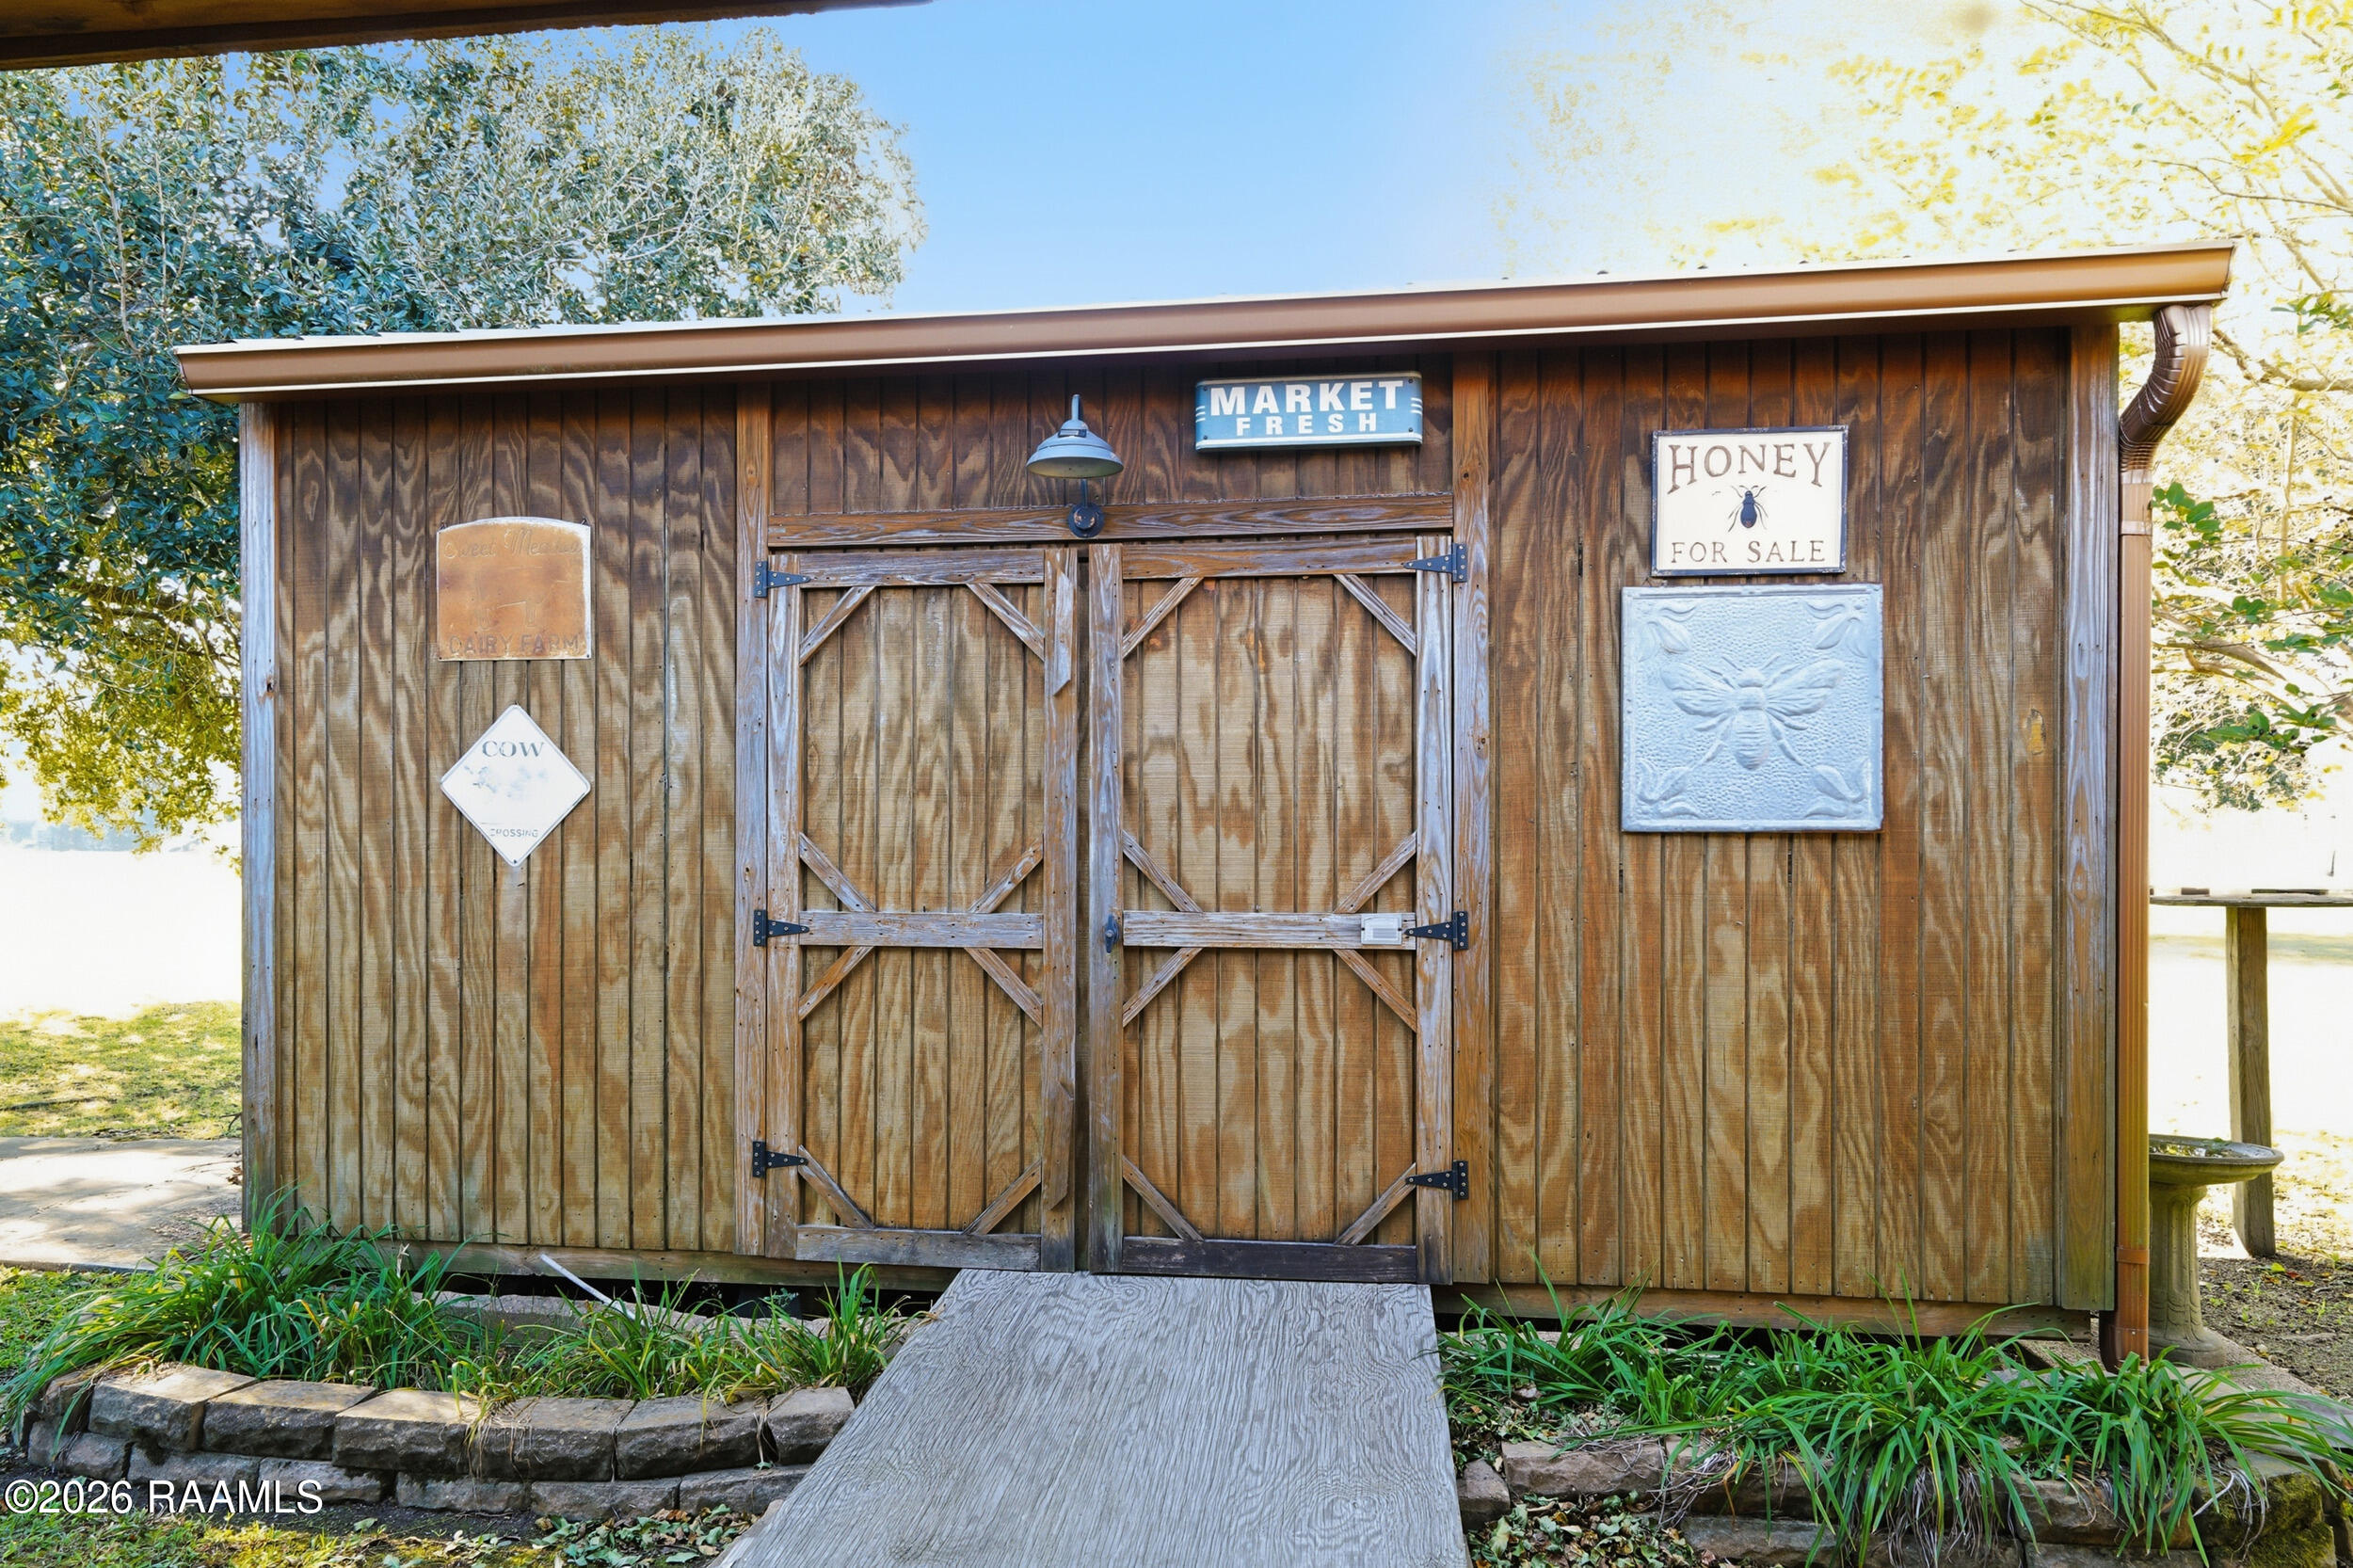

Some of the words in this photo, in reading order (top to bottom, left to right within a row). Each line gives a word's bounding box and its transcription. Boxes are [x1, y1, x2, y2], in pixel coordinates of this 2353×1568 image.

[1210, 380, 1403, 416] MARKET
[1236, 412, 1377, 437] FRESH
[1667, 441, 1831, 494] HONEY
[1671, 541, 1728, 564] FOR
[1747, 540, 1825, 563] SALE
[449, 633, 513, 657] DAIRY
[520, 632, 581, 655] FARM
[482, 740, 544, 758] COW
